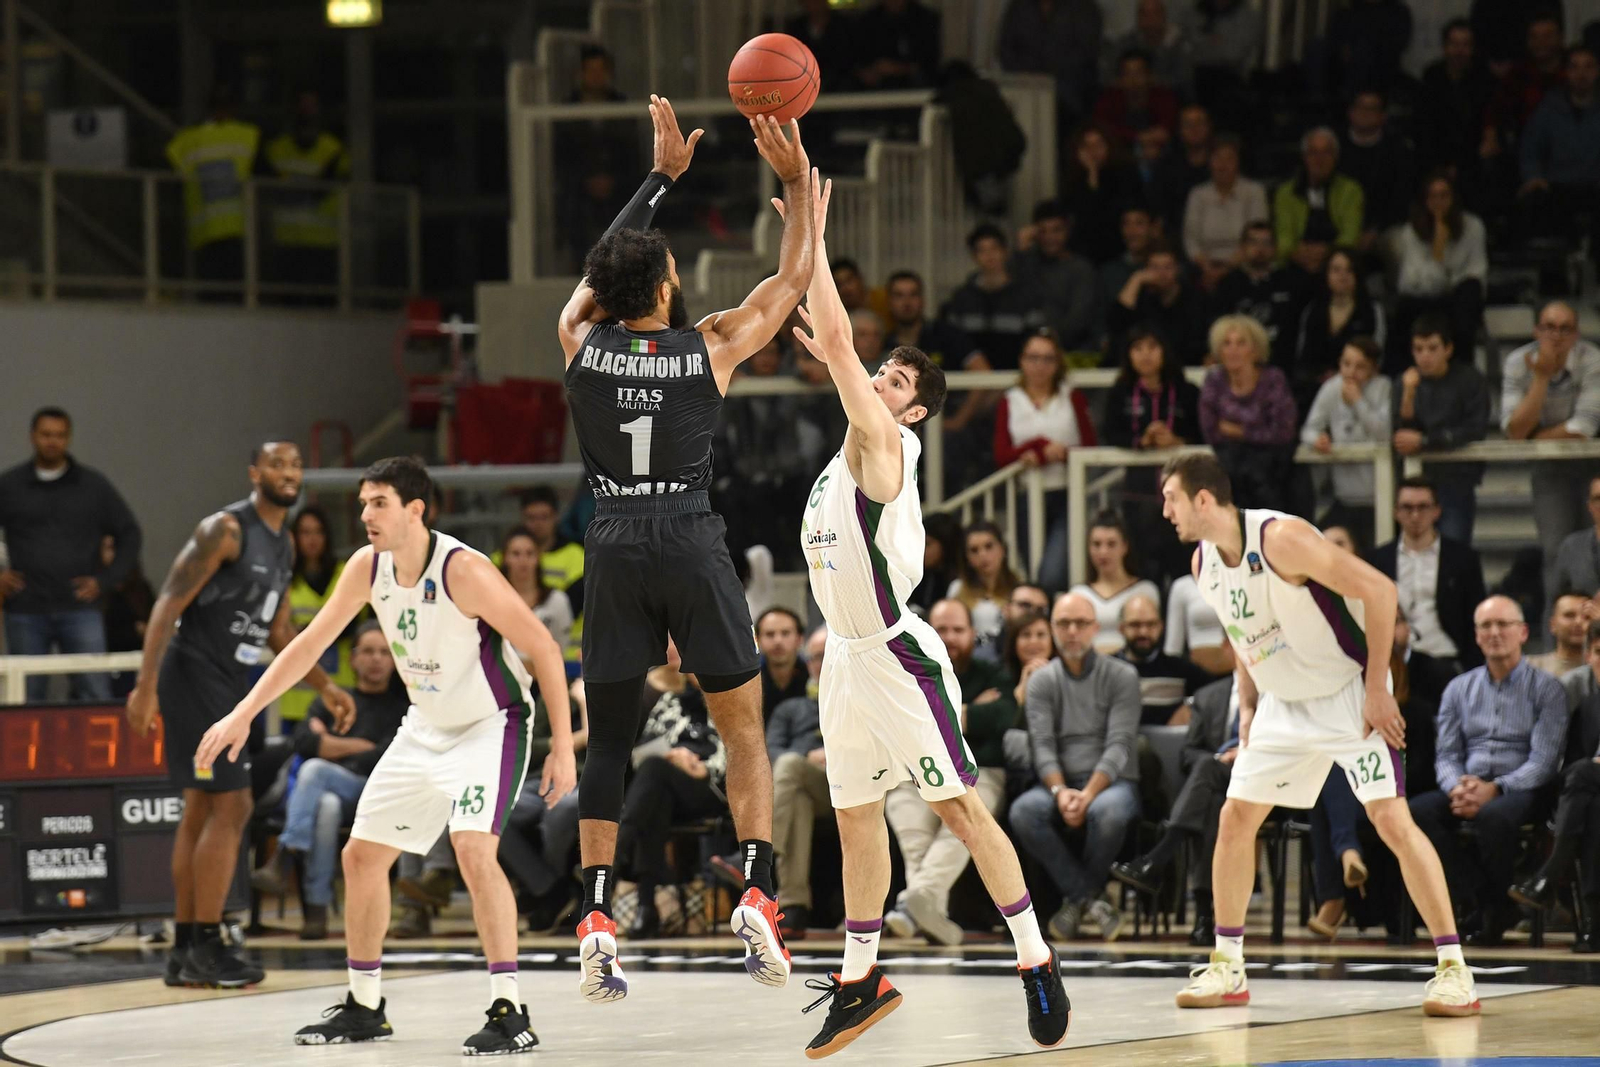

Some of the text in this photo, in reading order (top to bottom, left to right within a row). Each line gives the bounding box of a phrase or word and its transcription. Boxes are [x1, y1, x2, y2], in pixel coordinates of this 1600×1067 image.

[581, 345, 704, 379] BLACKMON JR
[616, 387, 664, 402] ITAS
[616, 400, 661, 411] MUTUA
[619, 415, 653, 476] 1
[1229, 588, 1255, 619] 32
[397, 608, 418, 640] 43
[407, 659, 440, 672] Unicaja
[919, 756, 944, 787] 8
[1356, 751, 1387, 784] 32
[122, 797, 187, 824] GUE
[458, 785, 485, 816] 43
